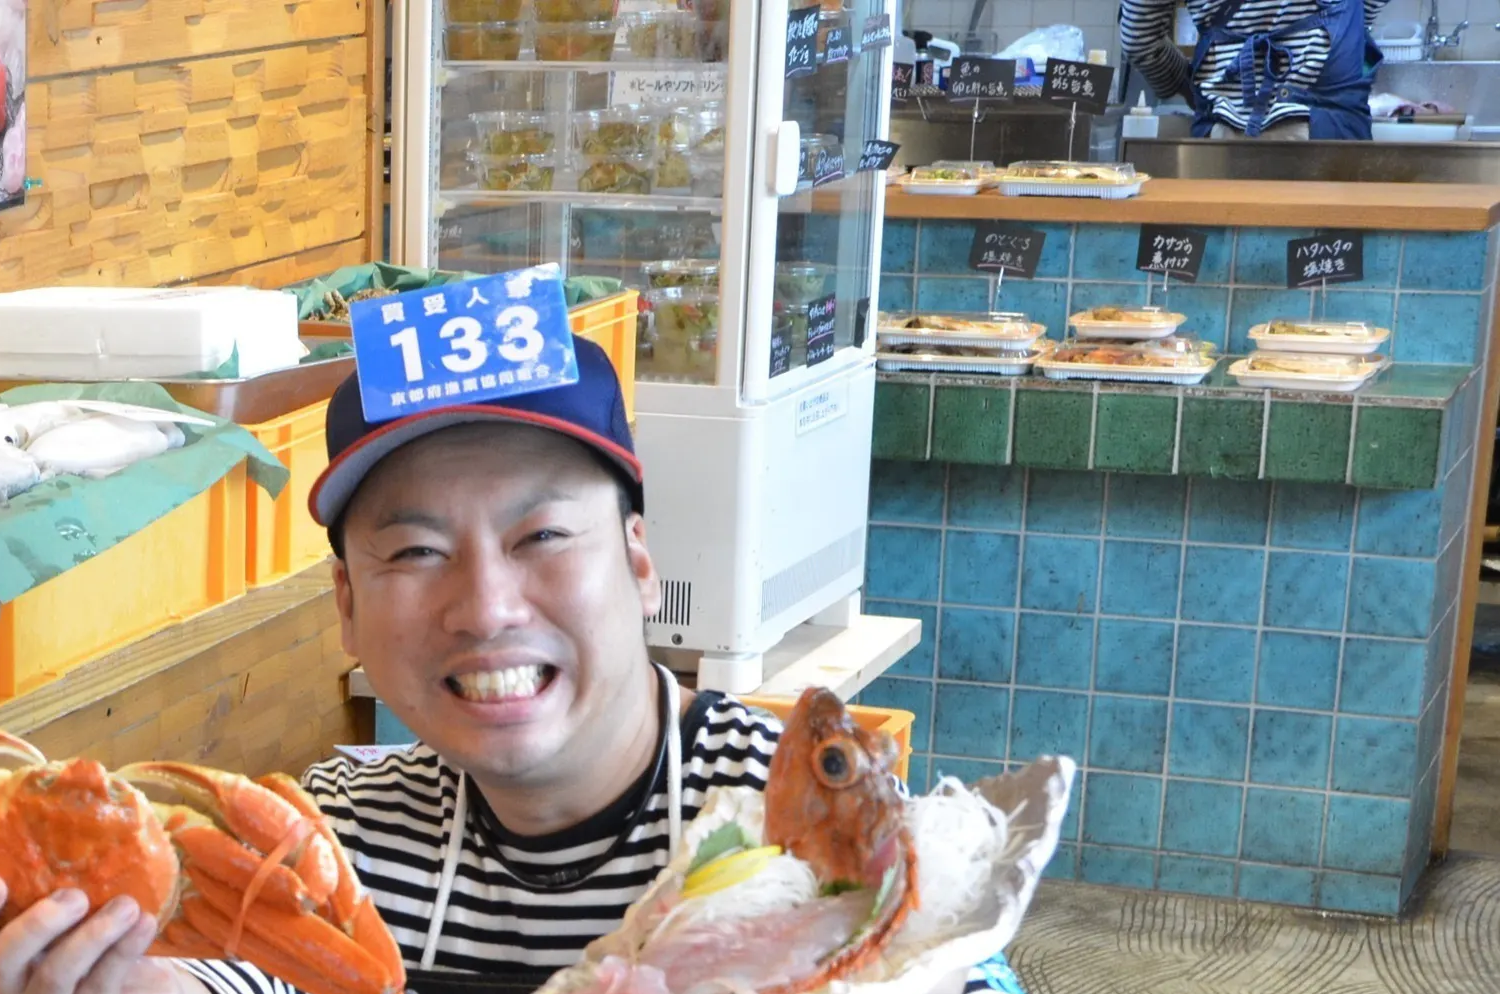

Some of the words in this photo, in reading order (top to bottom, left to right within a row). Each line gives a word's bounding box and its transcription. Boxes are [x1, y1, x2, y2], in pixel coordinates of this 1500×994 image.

[1152, 235, 1193, 255] カサゴの
[1296, 239, 1353, 259] ハタハタの
[1149, 250, 1189, 269] 煮付け
[1302, 258, 1346, 278] 塩焼き
[390, 304, 545, 383] 133
[391, 364, 551, 407] 京都府漁業協同組合
